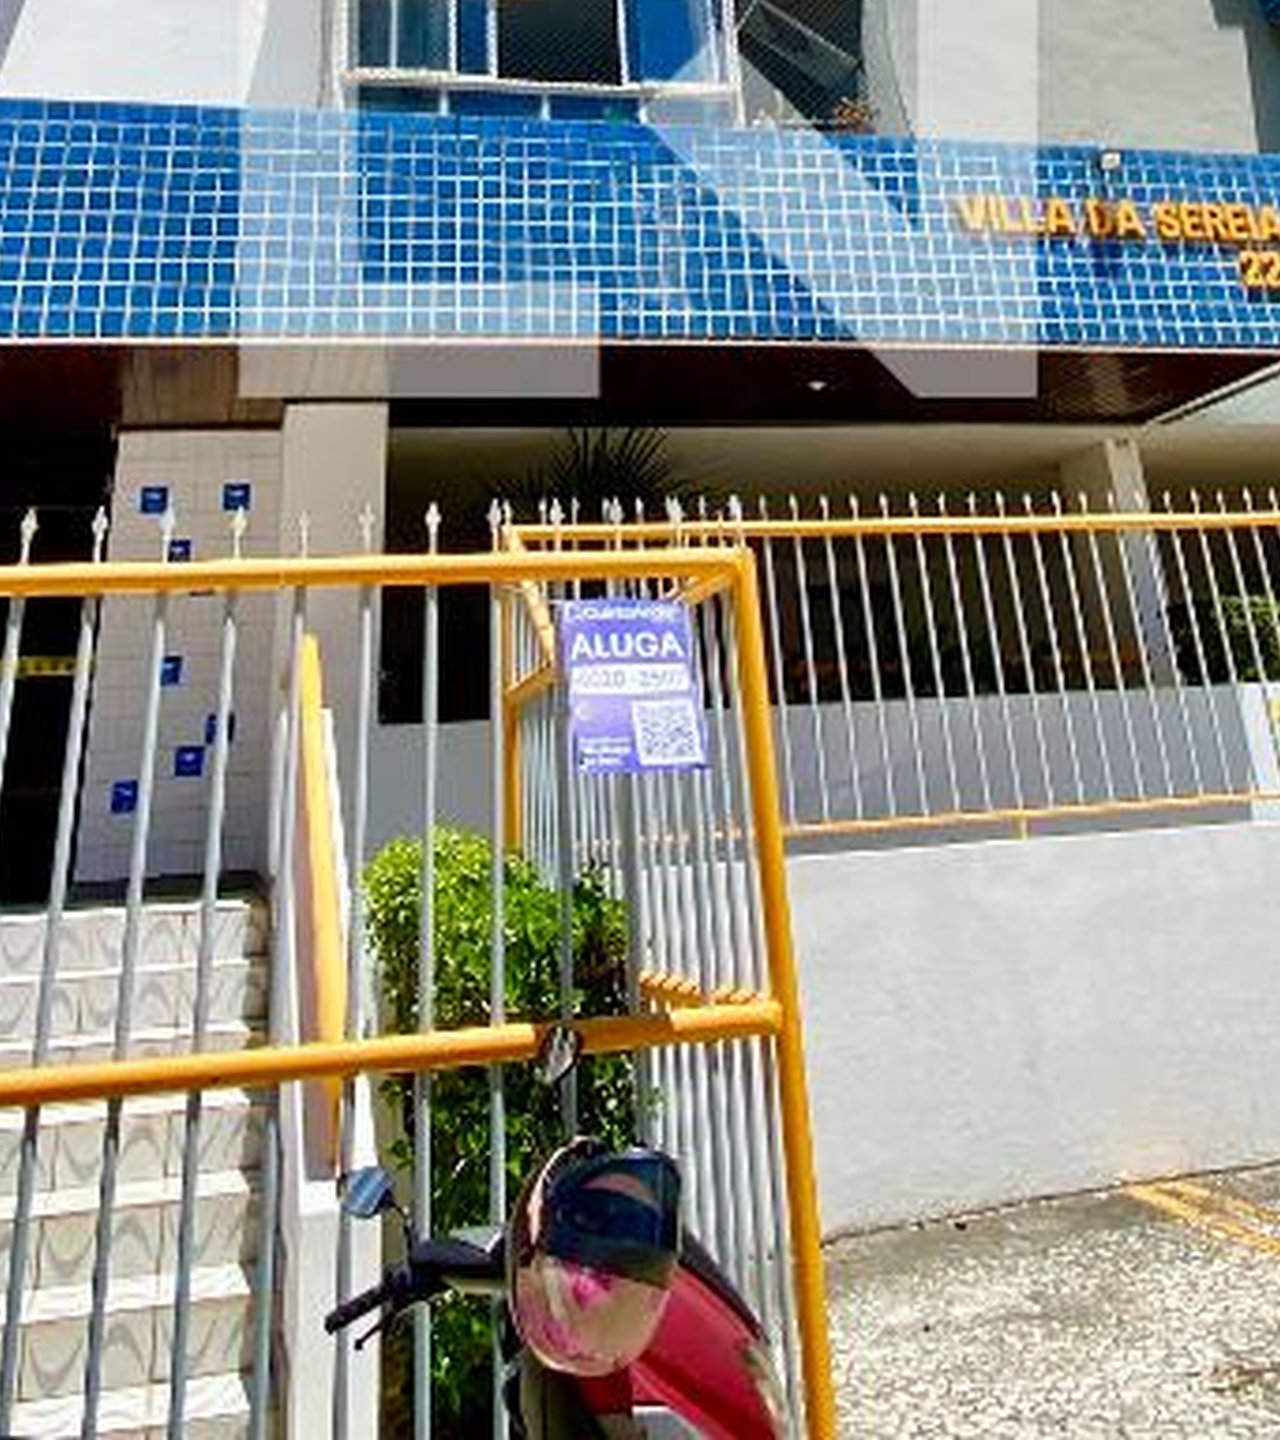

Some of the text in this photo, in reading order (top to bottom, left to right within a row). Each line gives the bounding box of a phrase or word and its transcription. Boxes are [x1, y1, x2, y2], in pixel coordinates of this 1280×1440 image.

[958, 195, 1075, 235] VILLA
[1086, 198, 1145, 239] DA
[571, 631, 685, 660] ALUGA
